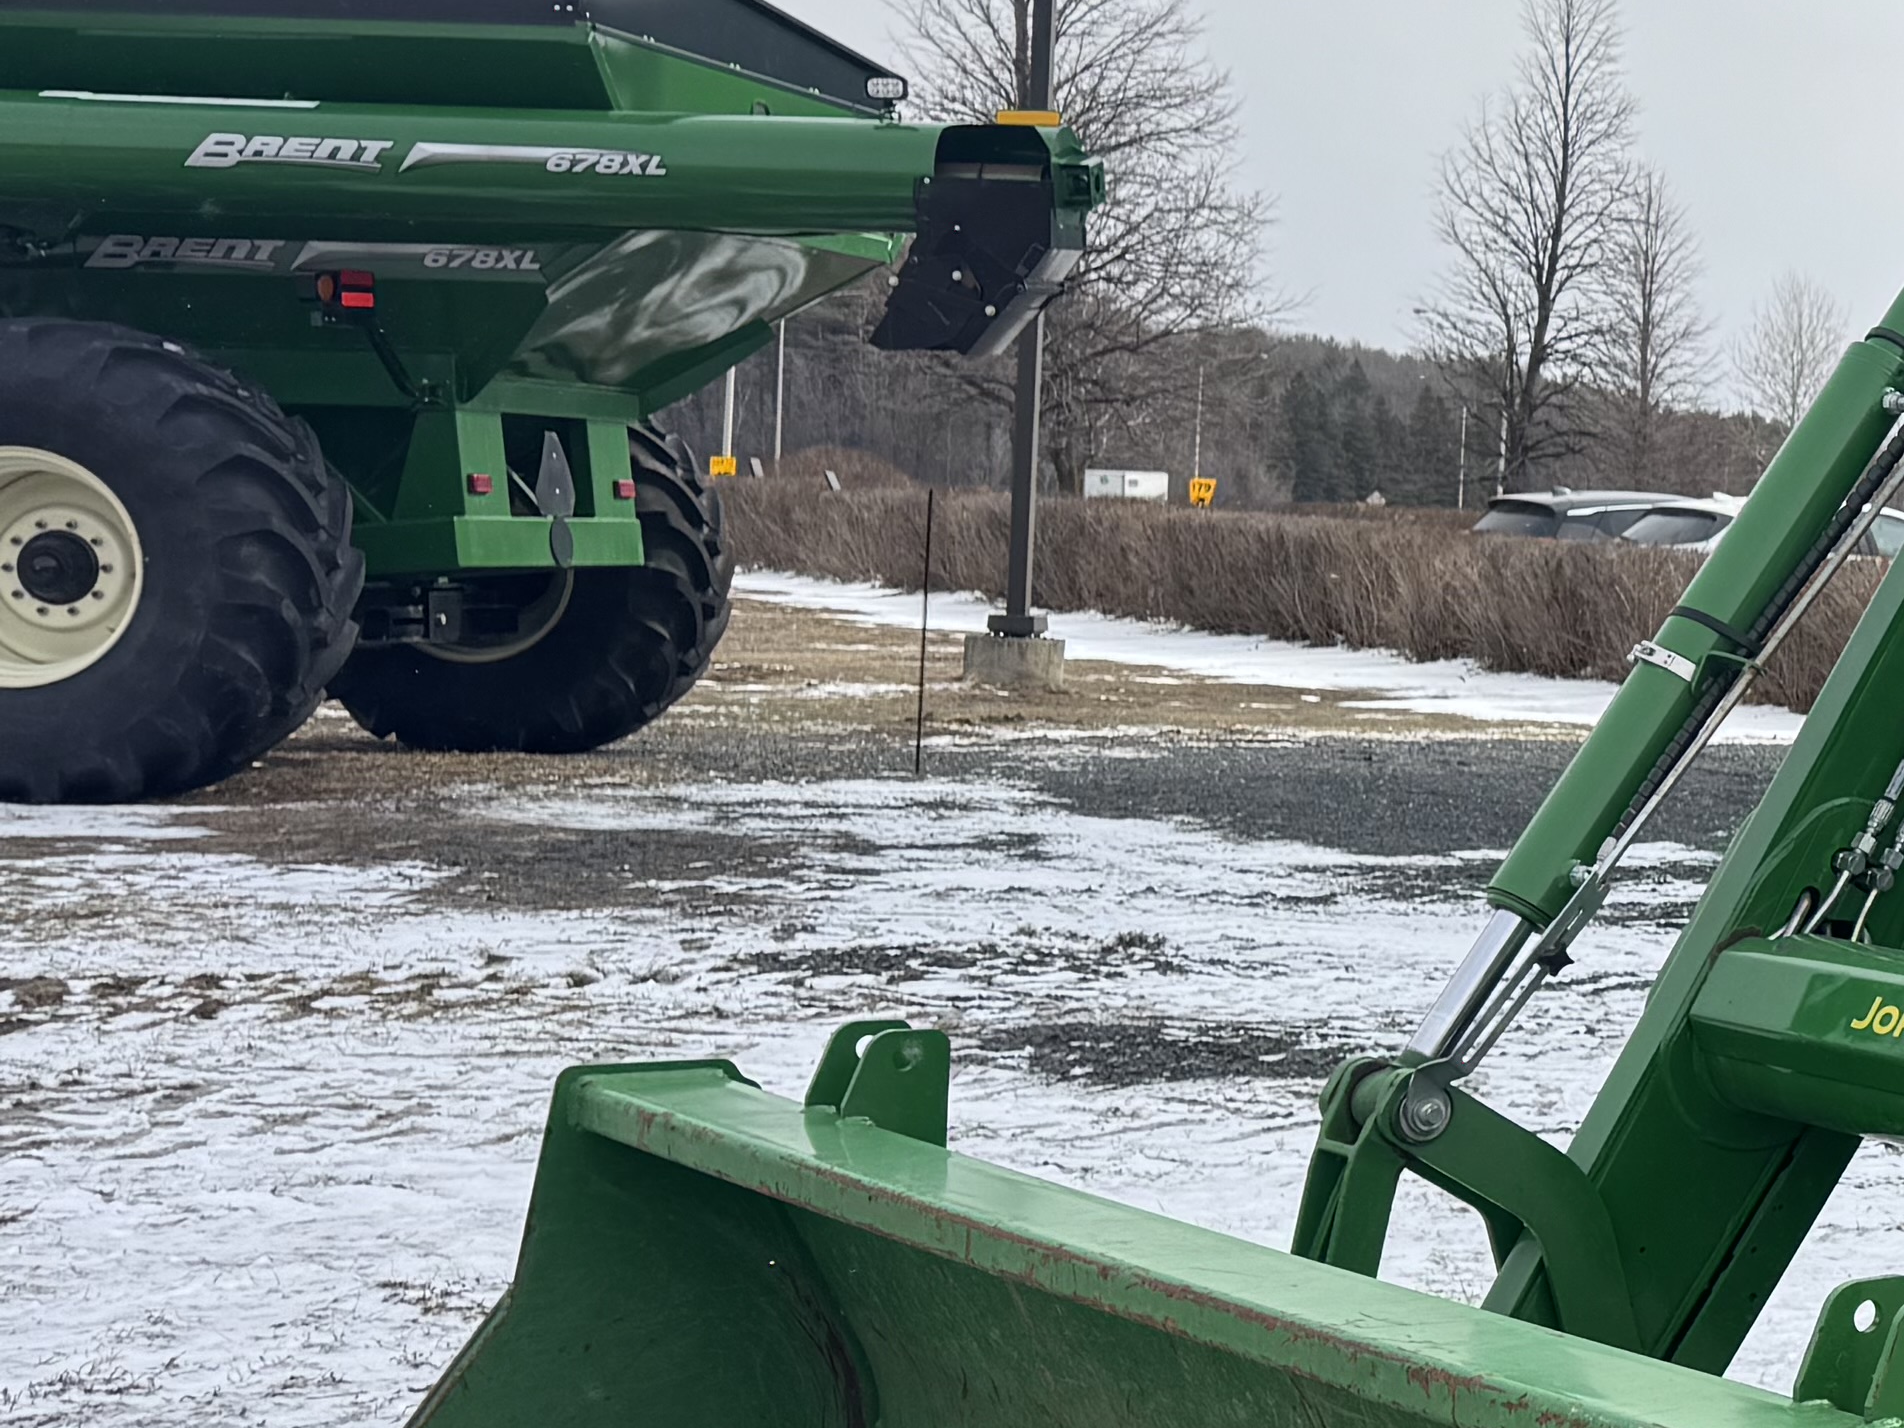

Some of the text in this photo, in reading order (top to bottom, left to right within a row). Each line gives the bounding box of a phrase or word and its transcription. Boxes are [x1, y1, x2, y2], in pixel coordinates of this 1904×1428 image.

[184, 132, 667, 176] BRENT 678XL
[84, 234, 541, 271] BRENT 678XL
